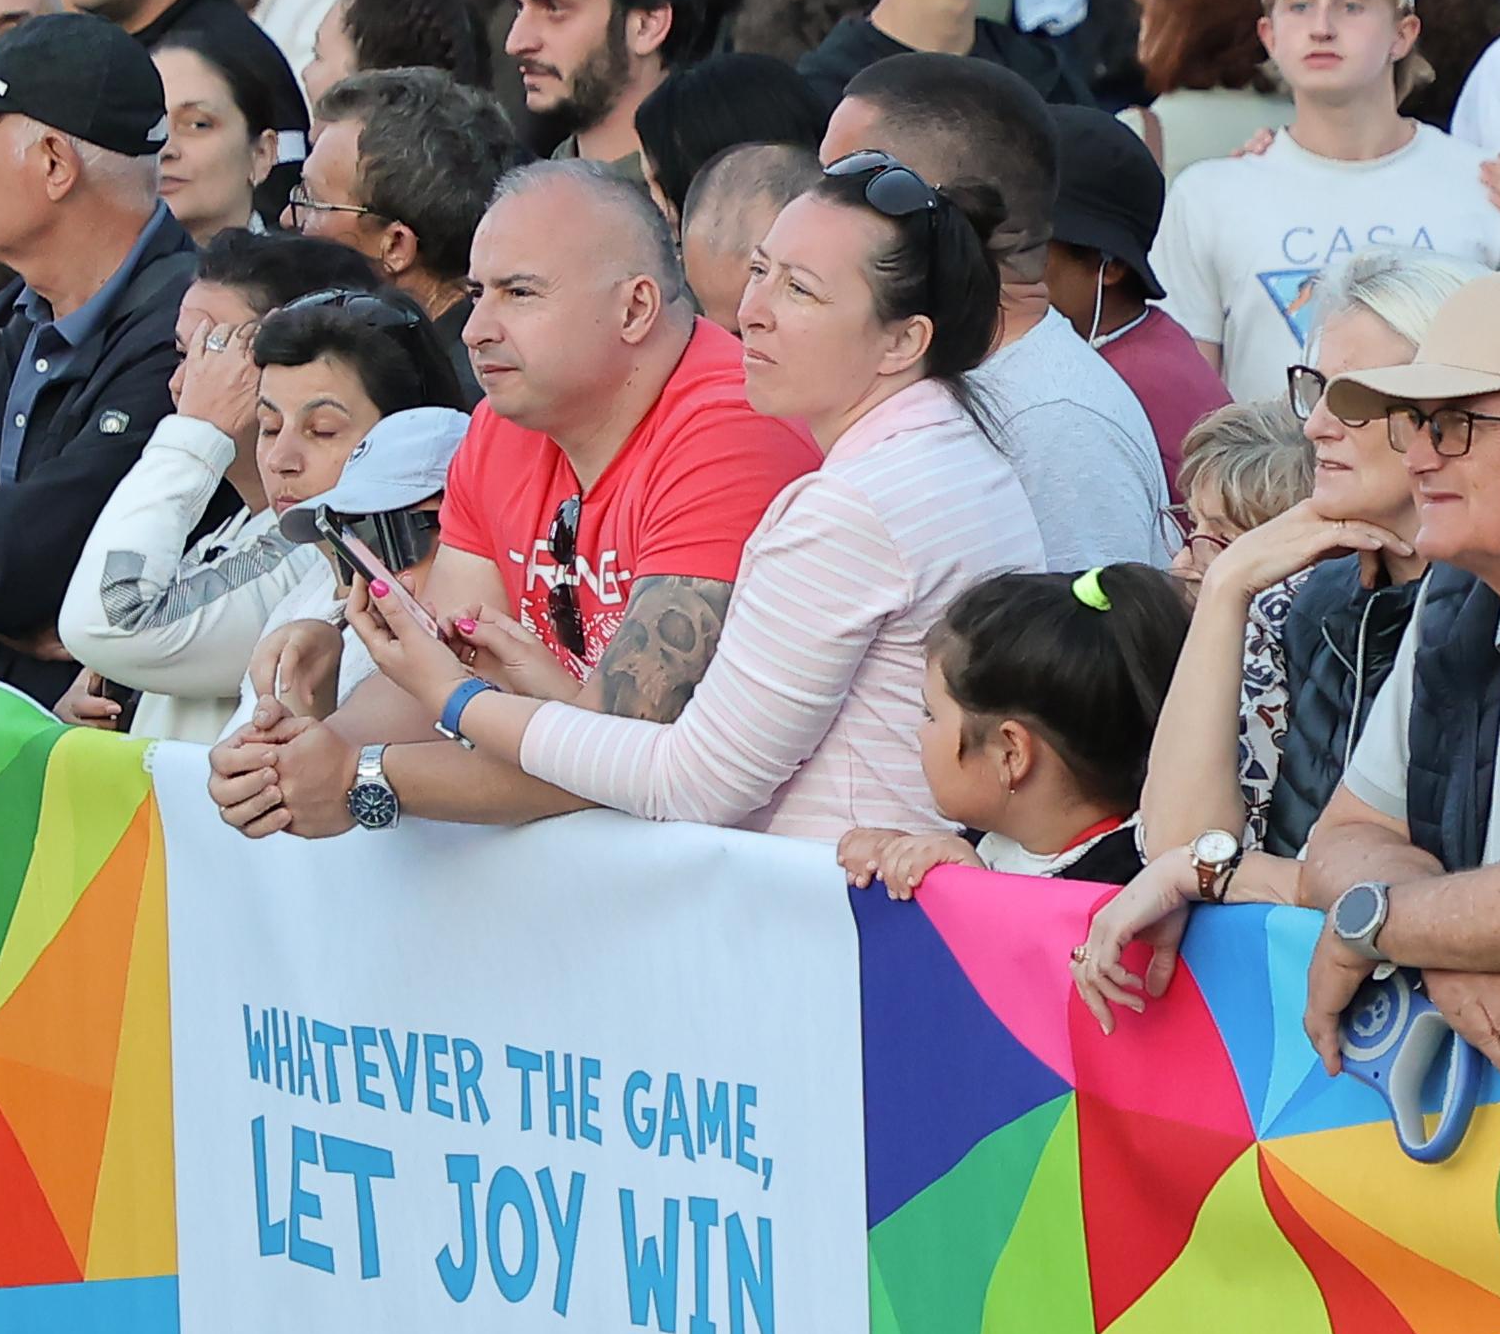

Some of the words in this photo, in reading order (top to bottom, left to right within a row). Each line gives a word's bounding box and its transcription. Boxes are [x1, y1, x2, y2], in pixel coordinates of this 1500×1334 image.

[1281, 225, 1436, 266] CASA
[243, 1003, 490, 1125] WHATEVER
[505, 1044, 602, 1146] THE
[623, 1070, 773, 1191] GAME,
[251, 1115, 396, 1281] LET
[435, 1153, 586, 1318] JOY
